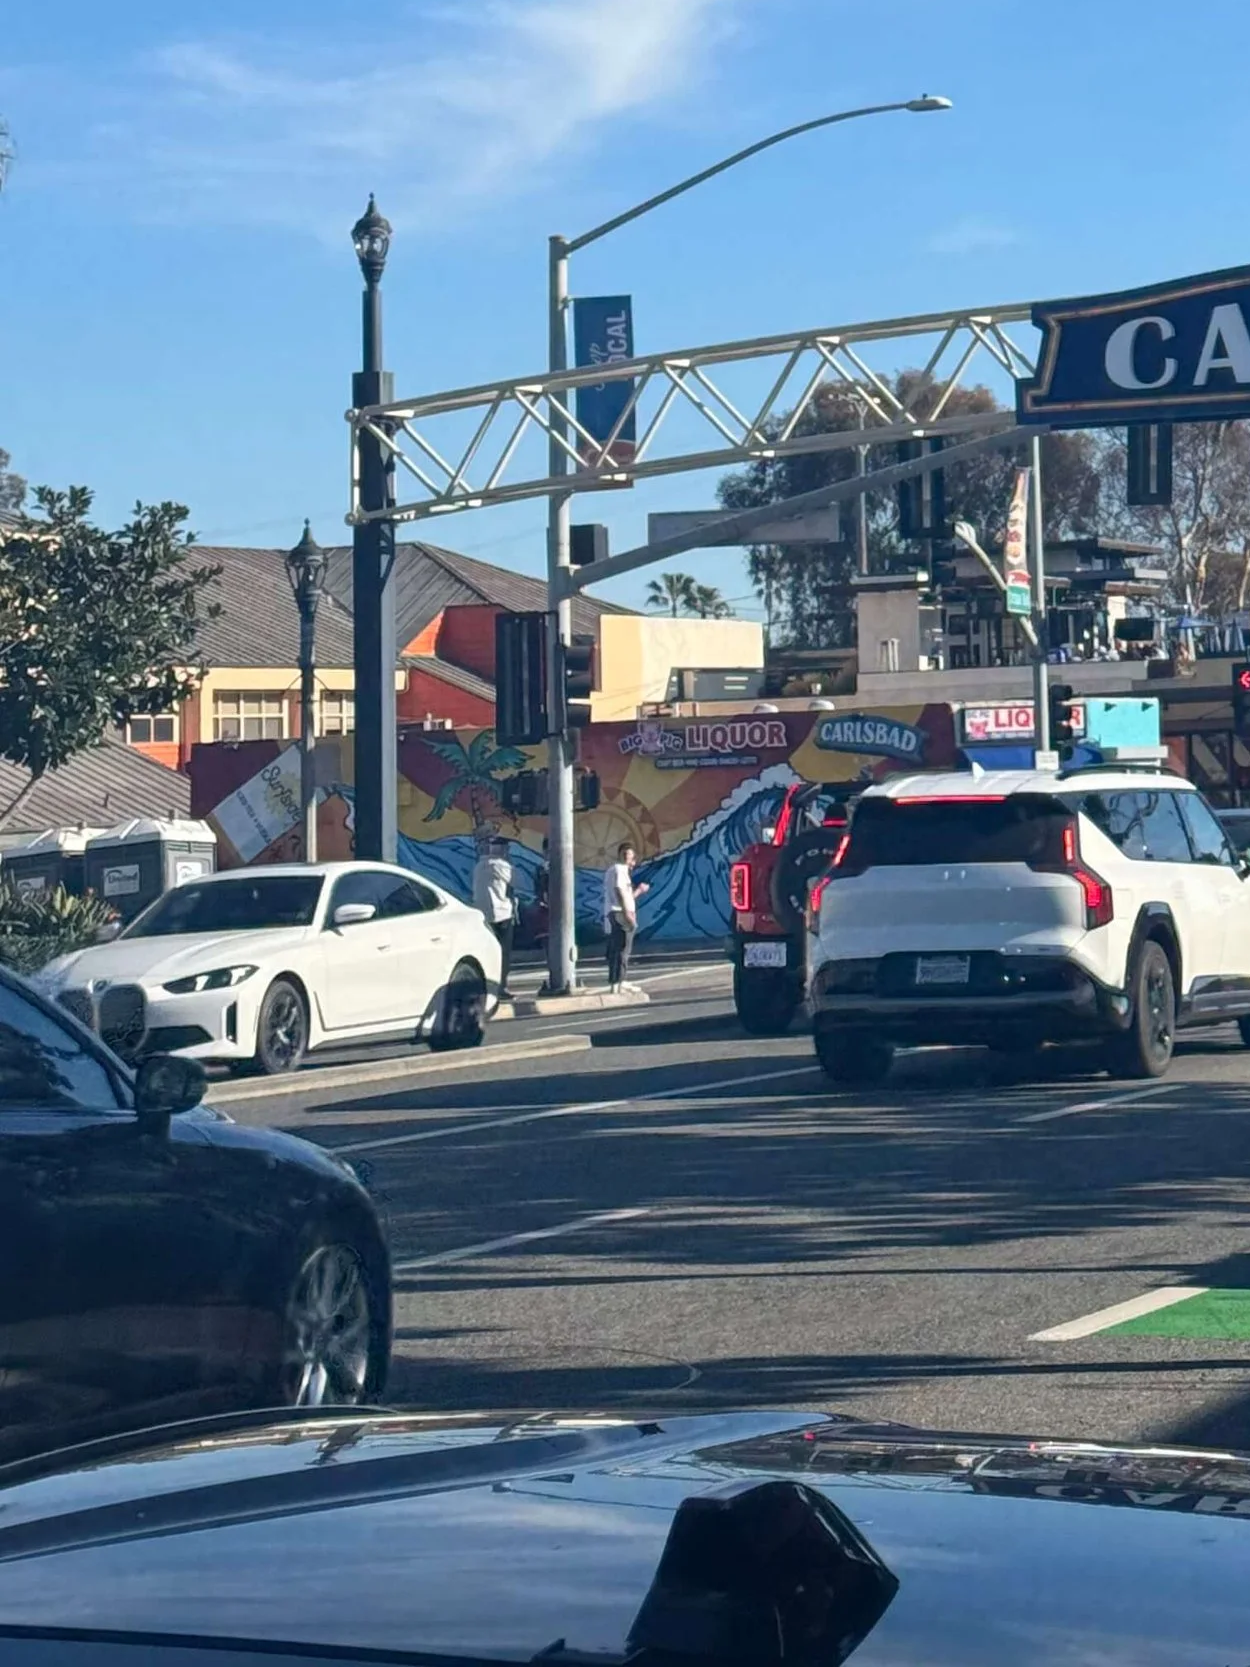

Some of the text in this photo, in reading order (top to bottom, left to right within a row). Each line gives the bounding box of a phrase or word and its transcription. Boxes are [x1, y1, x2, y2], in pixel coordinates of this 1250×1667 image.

[605, 309, 628, 361] OCAL
[994, 709, 1082, 729] LIQR
[618, 721, 787, 754] BIG PIG LIQUOR
[820, 721, 917, 752] CARLSBAD
